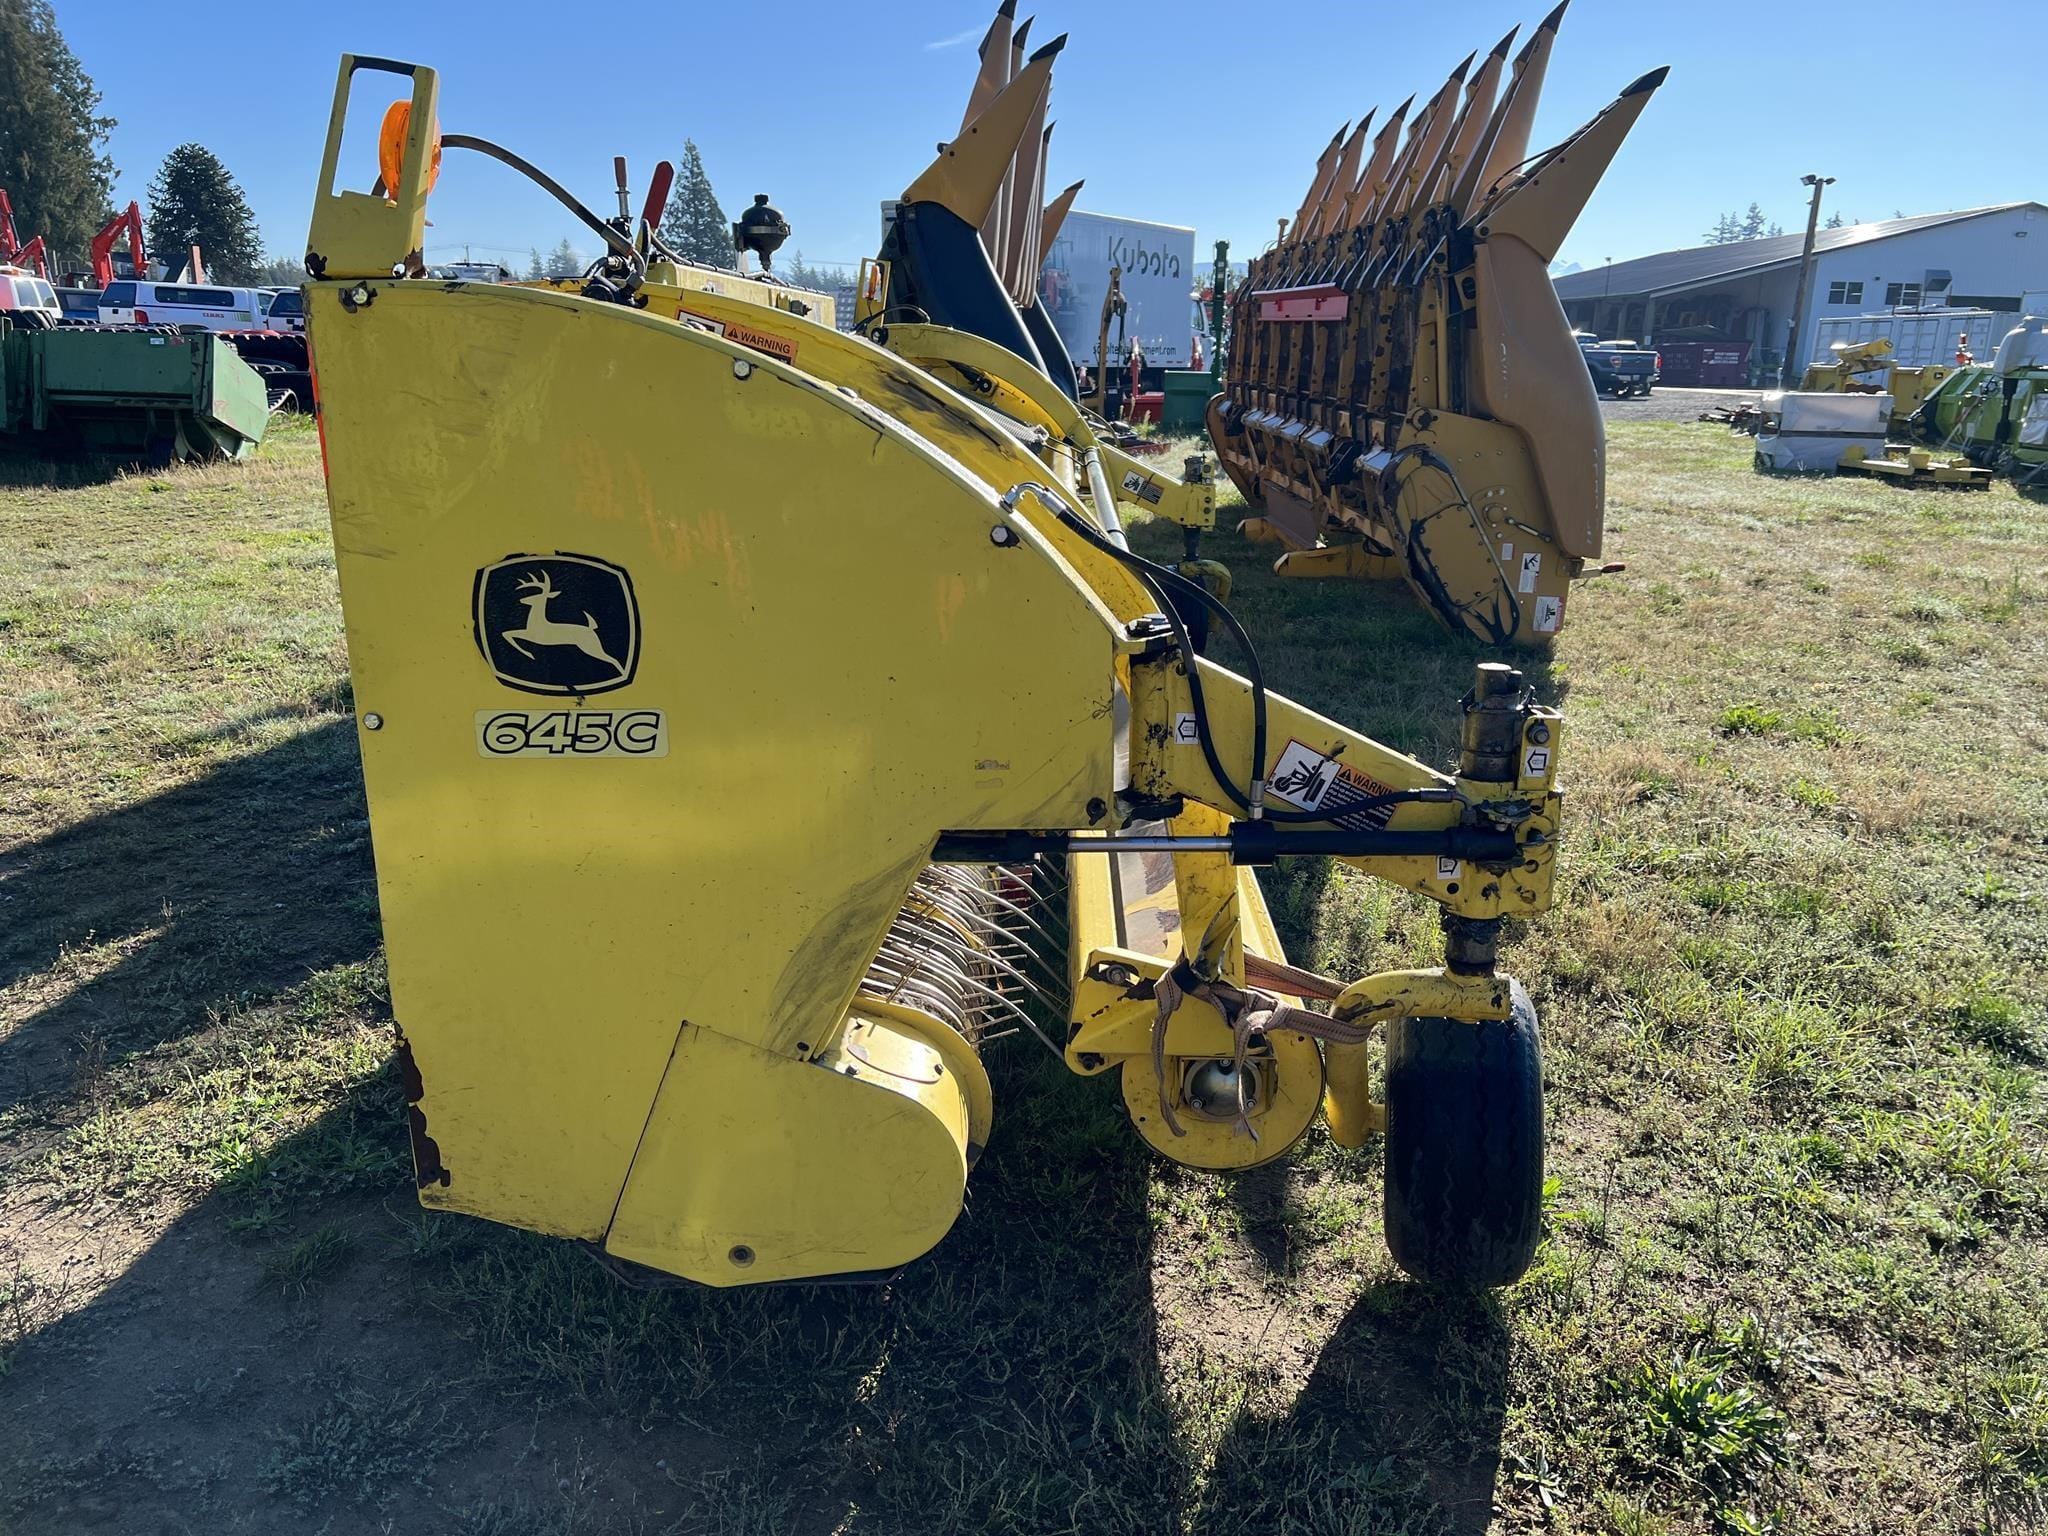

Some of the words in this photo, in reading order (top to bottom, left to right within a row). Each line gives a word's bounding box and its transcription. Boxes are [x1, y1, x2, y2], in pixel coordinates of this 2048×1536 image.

[1108, 236, 1179, 278] Kubota
[740, 331, 791, 354] WARNING
[482, 712, 661, 754] 645C
[1353, 773, 1394, 796] WARNI
